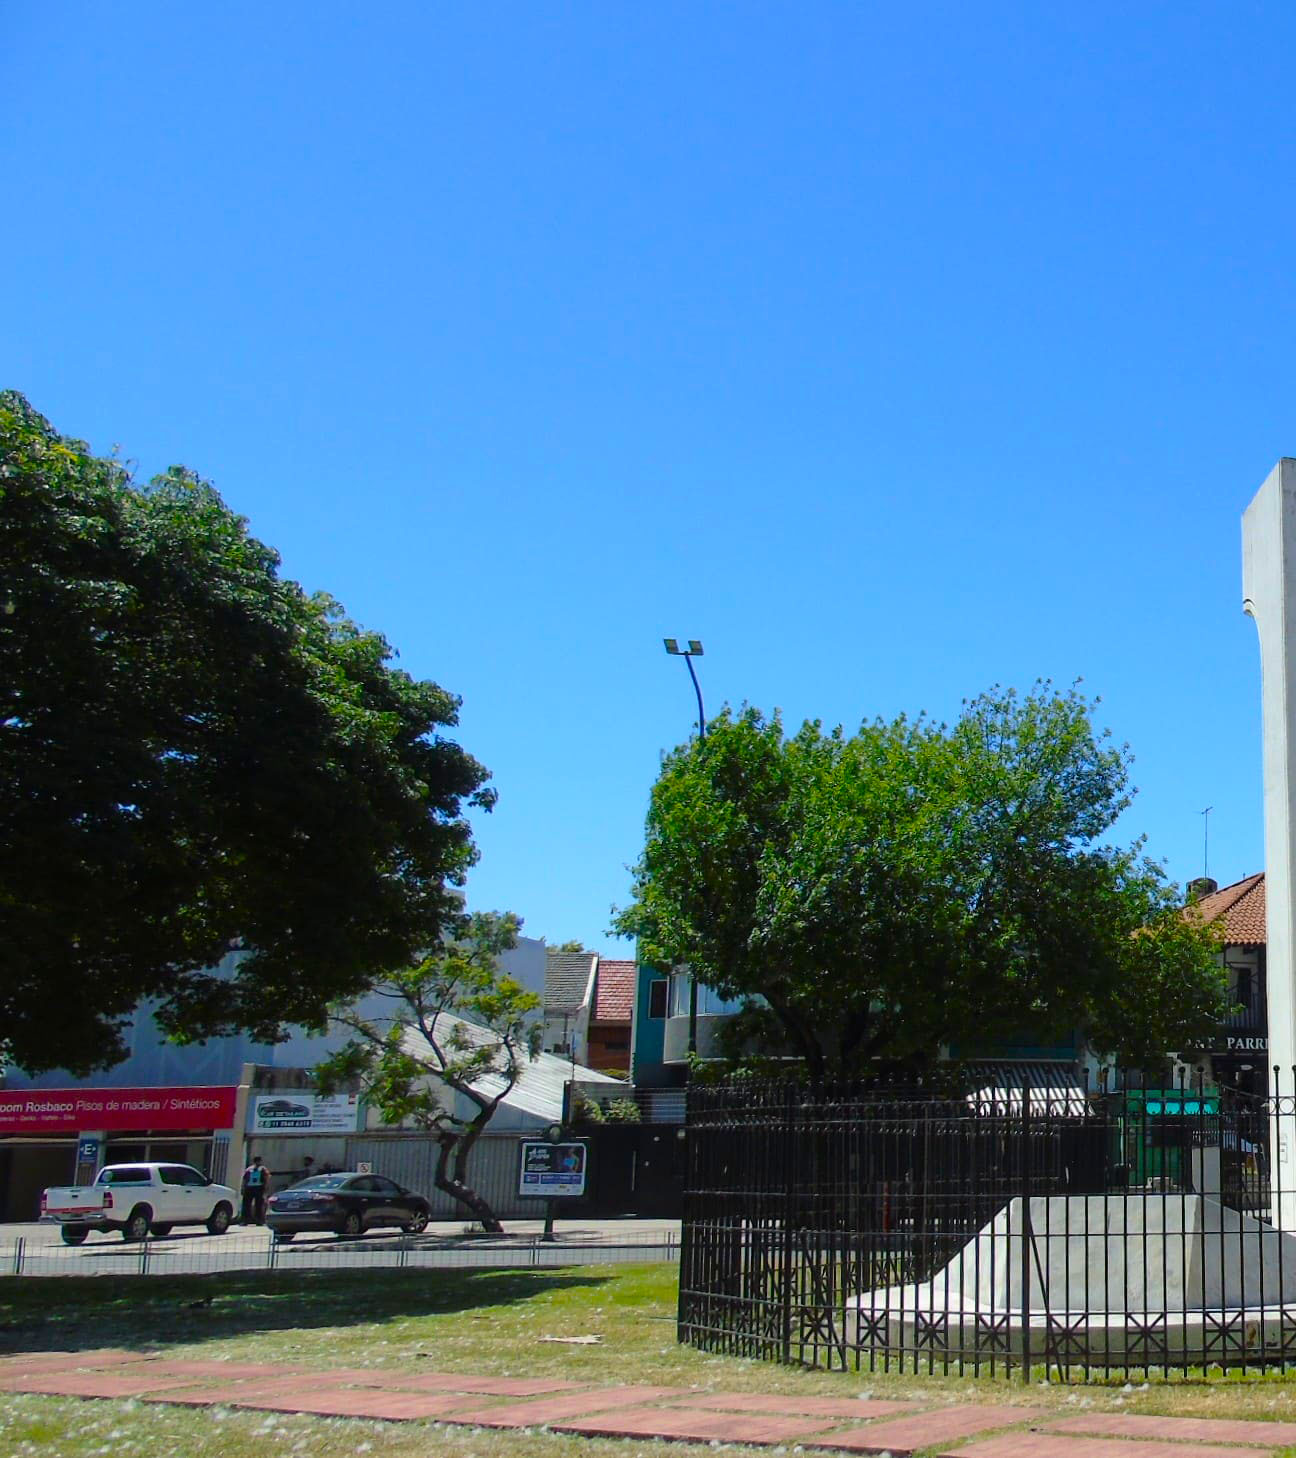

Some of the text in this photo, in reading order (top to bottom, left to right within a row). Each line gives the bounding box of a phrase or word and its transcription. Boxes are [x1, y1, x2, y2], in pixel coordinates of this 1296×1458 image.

[26, 1101, 73, 1112] Rosbaco
[75, 1099, 104, 1111] Pisos
[106, 1099, 119, 1111] de
[121, 1099, 160, 1111] madera
[170, 1098, 220, 1110] Sintéticos
[84, 1143, 93, 1155] E
